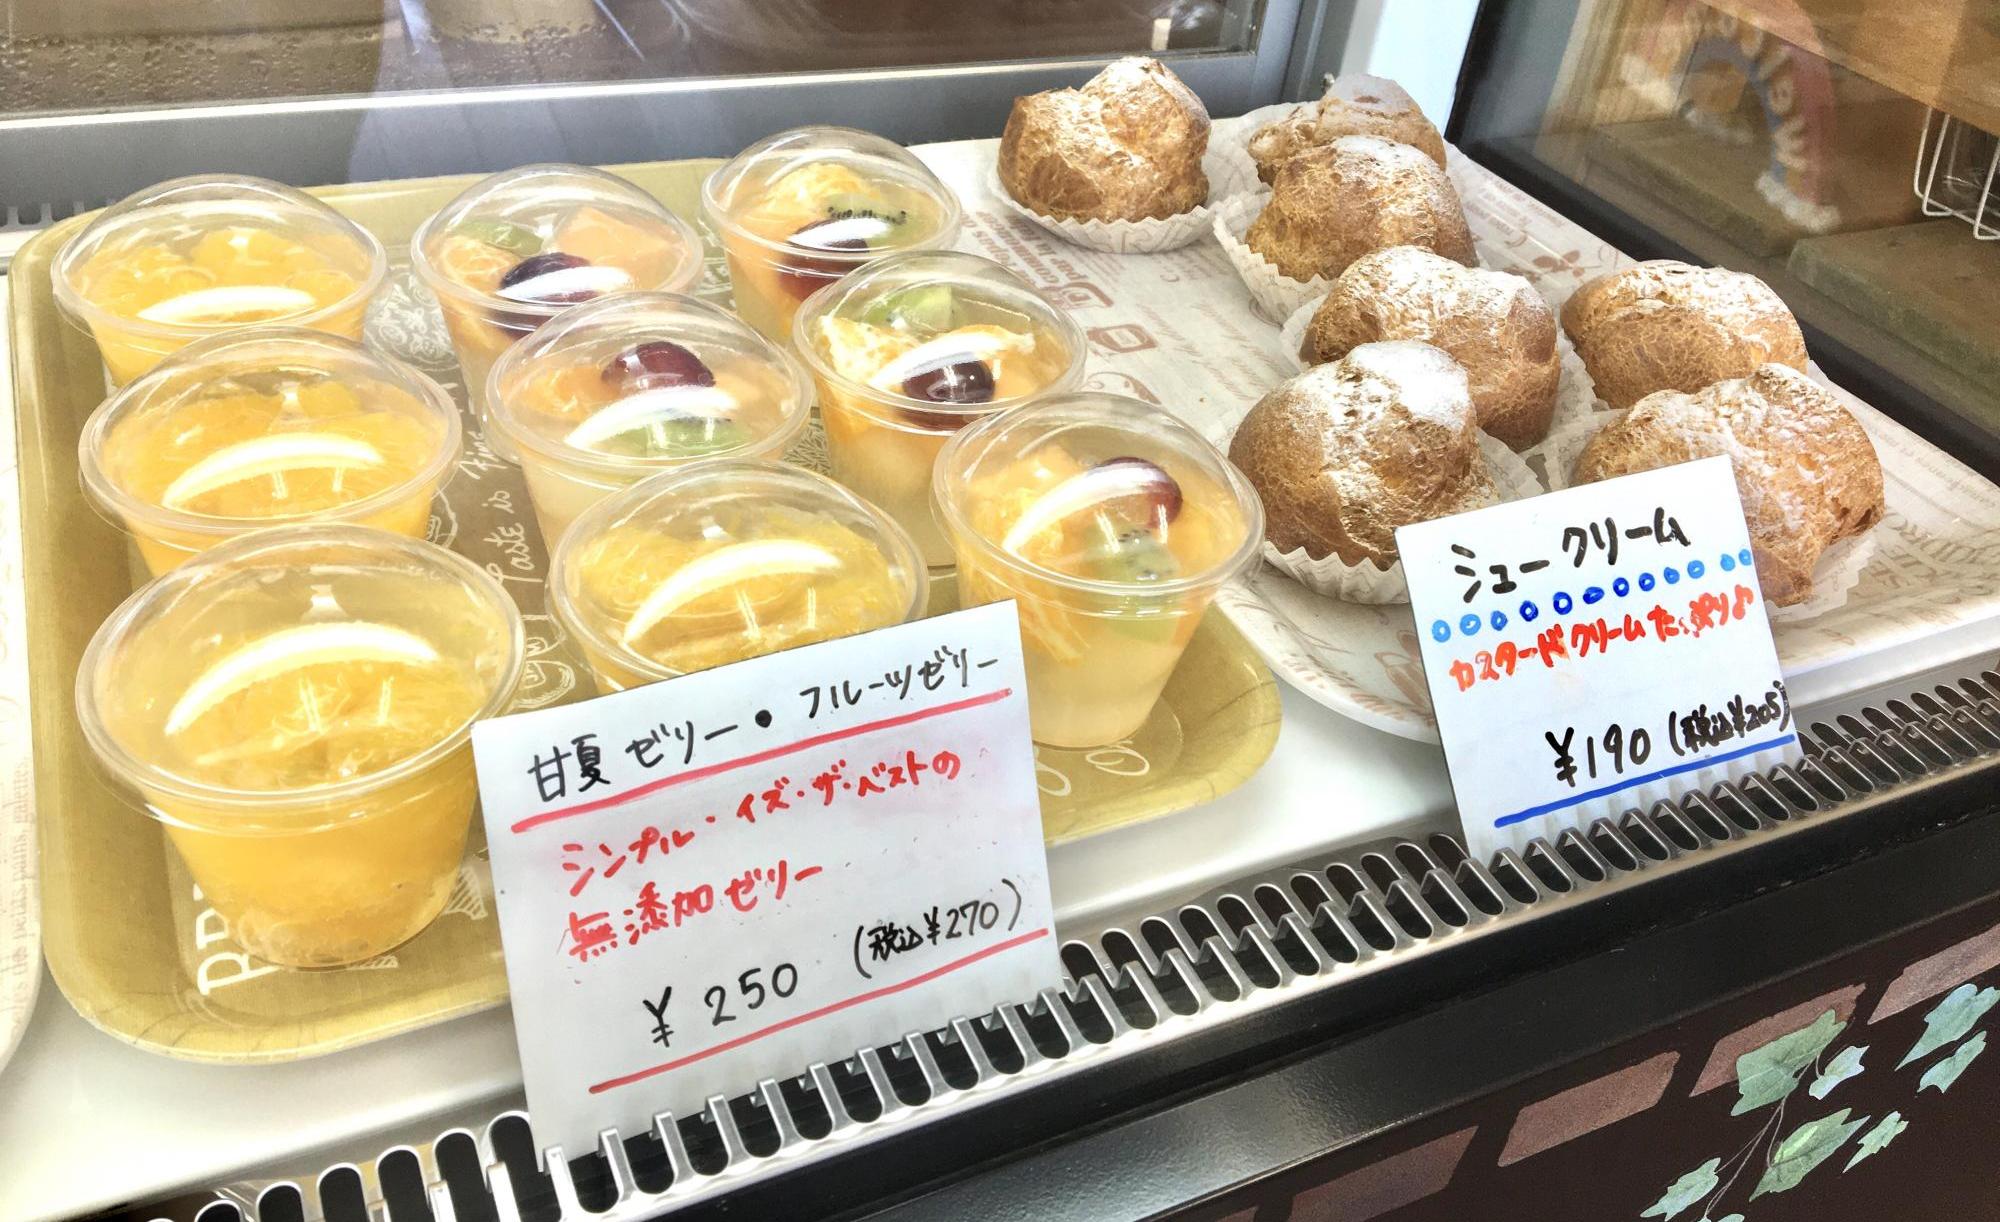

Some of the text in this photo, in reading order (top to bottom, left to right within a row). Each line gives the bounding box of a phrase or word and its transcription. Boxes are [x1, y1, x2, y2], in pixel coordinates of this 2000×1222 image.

[1546, 723, 1651, 787] ¥190
[567, 860, 824, 962] 無添加ゼリー
